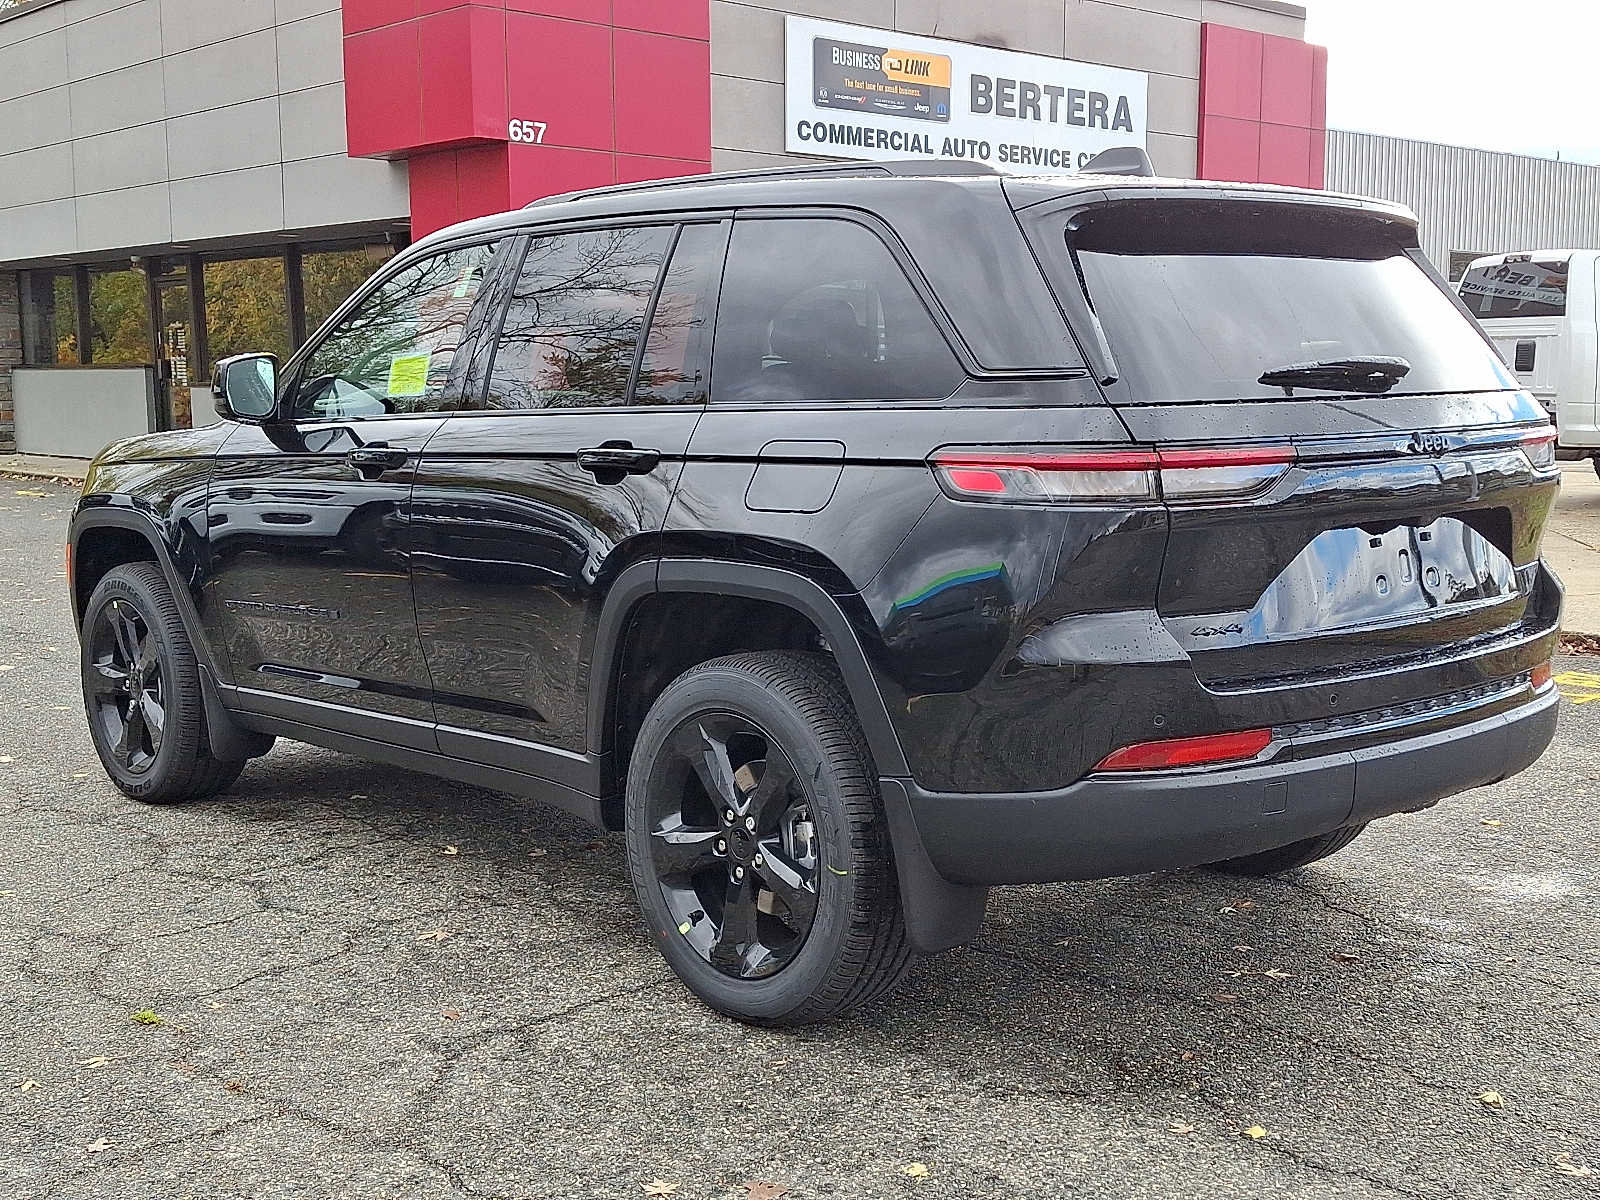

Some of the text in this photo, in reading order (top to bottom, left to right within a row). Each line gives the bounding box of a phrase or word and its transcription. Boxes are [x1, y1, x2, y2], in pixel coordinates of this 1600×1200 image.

[832, 47, 931, 77] BUSINESS LINK
[844, 78, 854, 88] The
[854, 79, 865, 90] fast
[914, 102, 930, 114] Jeep
[970, 73, 1134, 133] BERTERA
[508, 118, 547, 144] 657
[797, 119, 934, 156] COMMERCIAL
[941, 136, 992, 161] AUTO
[998, 143, 1071, 169] SERVICE
[1407, 431, 1449, 452] Jeep
